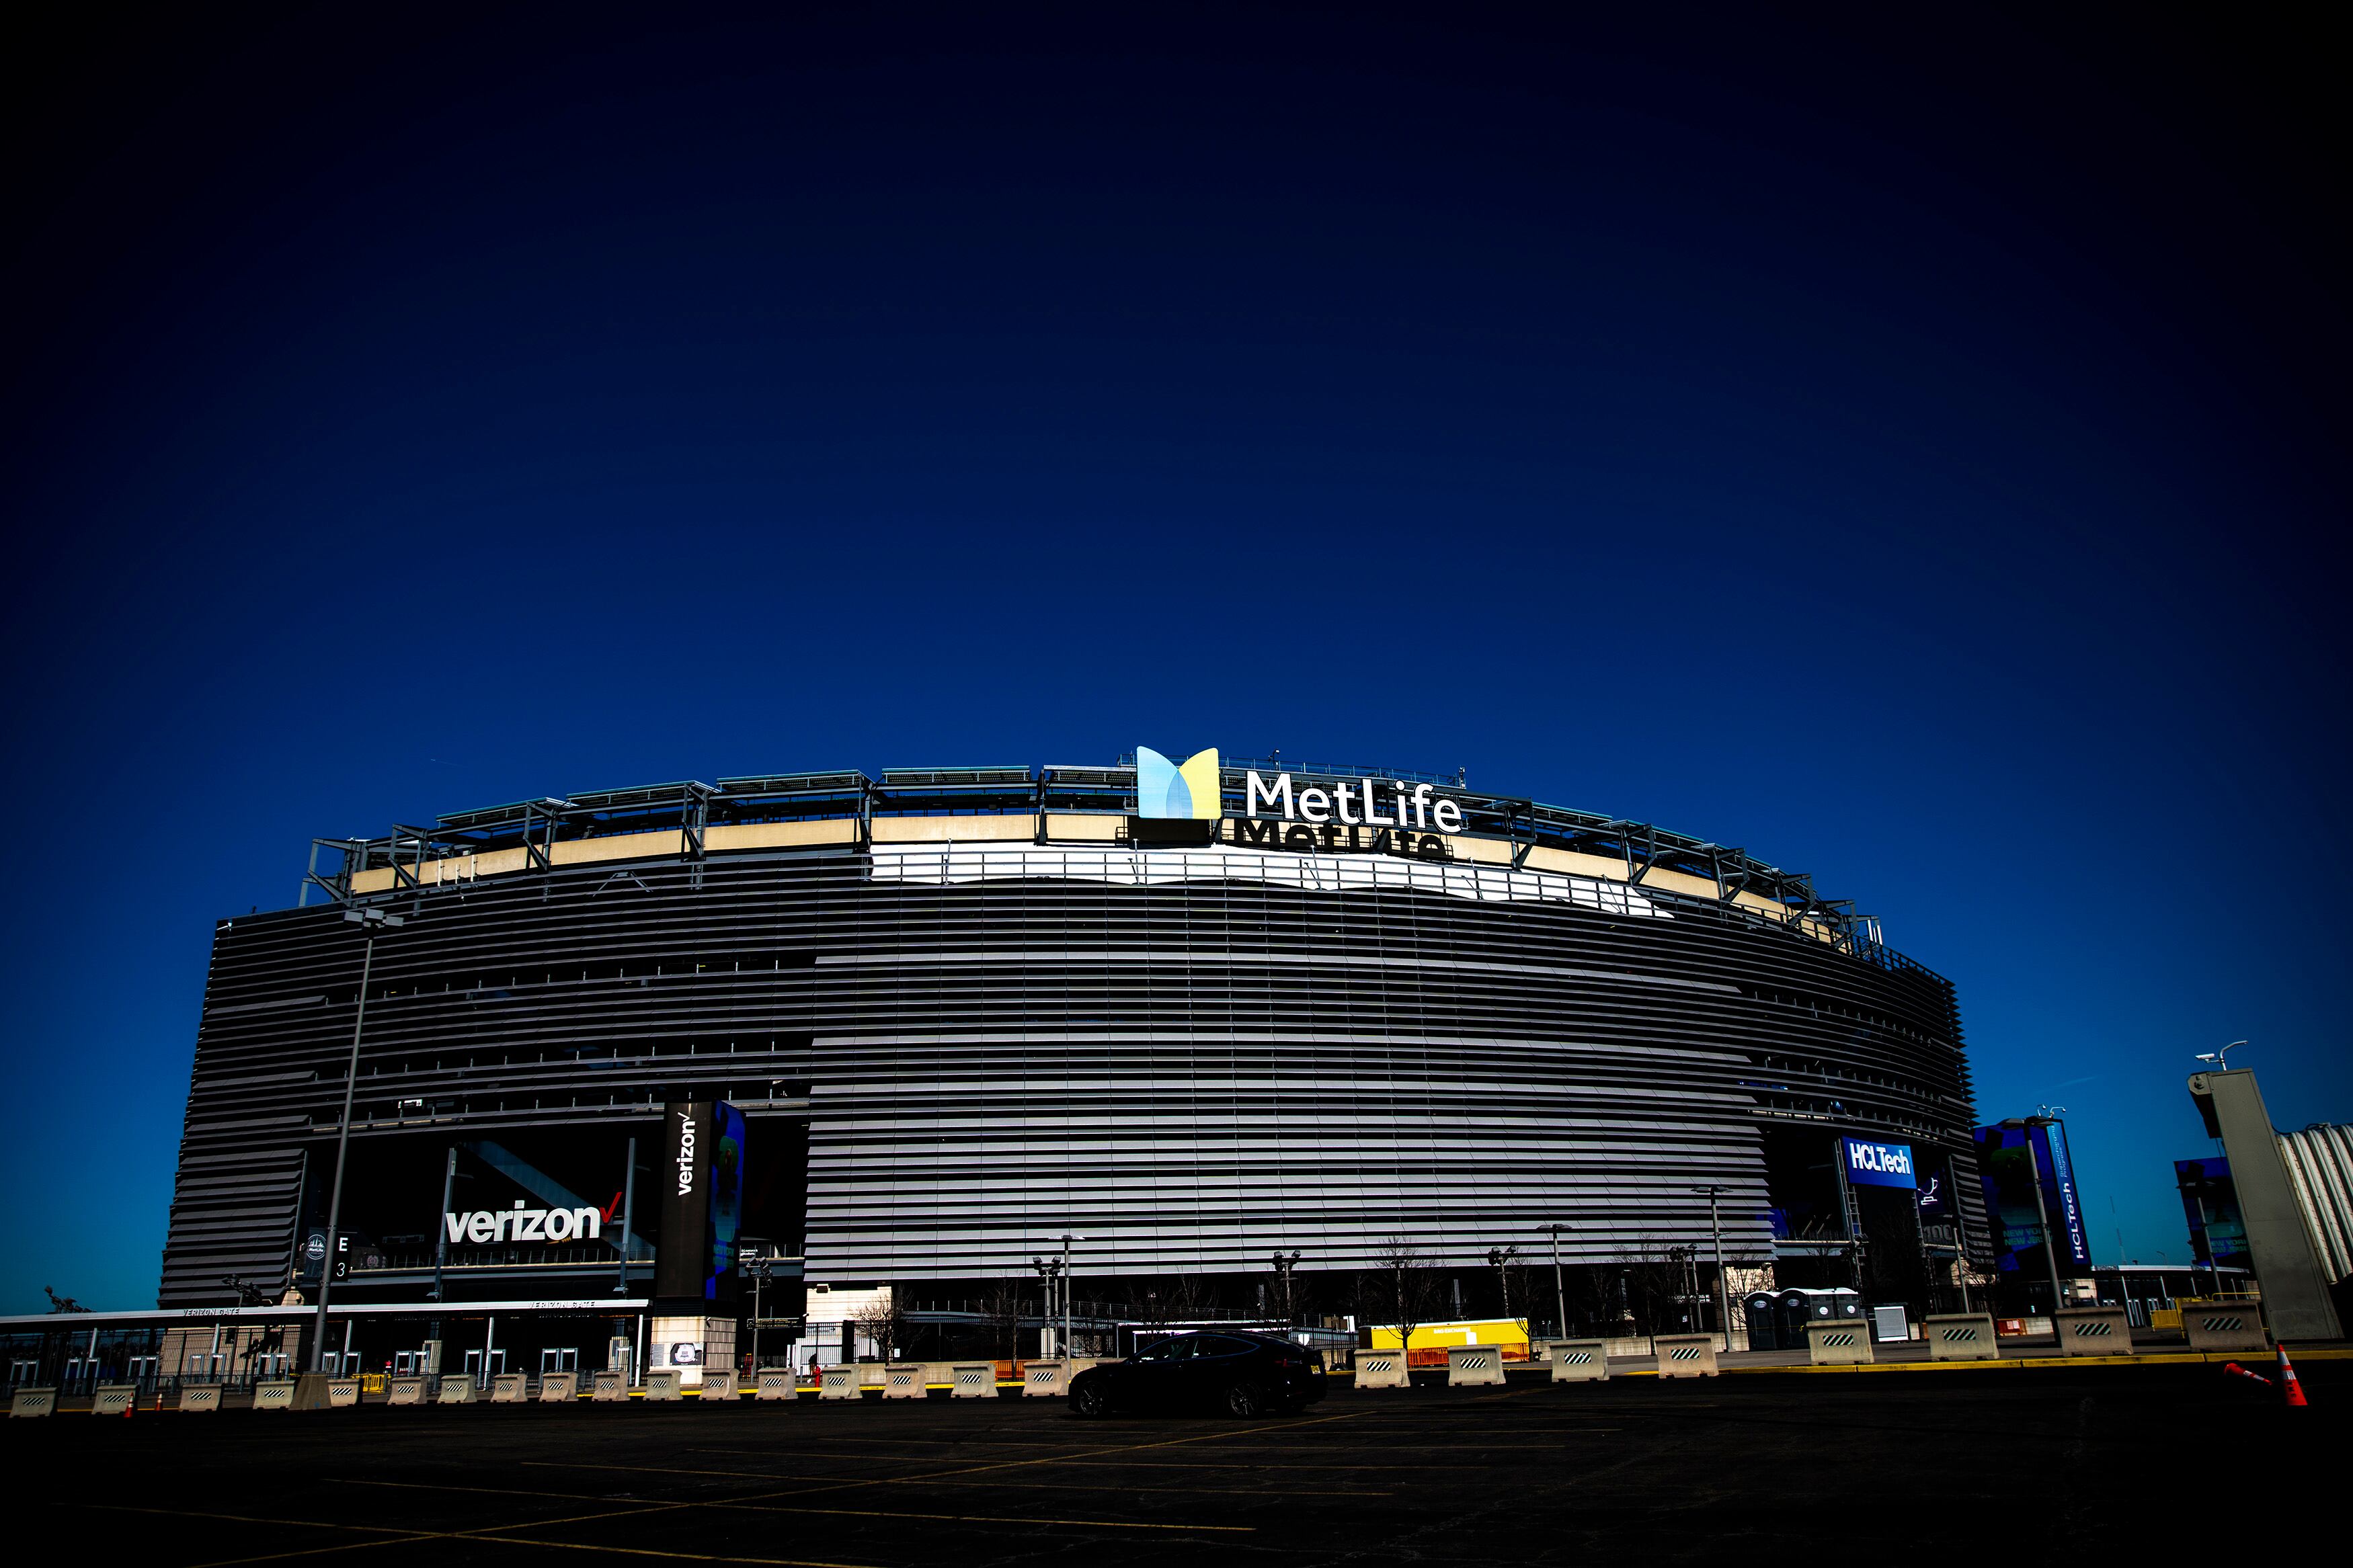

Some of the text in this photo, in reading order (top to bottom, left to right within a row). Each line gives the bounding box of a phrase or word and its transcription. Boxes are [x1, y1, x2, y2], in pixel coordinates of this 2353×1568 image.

[1245, 770, 1463, 834] MetLife
[676, 1120, 696, 1197] verizon
[1849, 1143, 1911, 1175] HCLTech
[445, 1200, 601, 1243] verizon
[2063, 1182, 2085, 1260] HCLTech
[339, 1237, 348, 1251] E
[336, 1262, 346, 1277] 3
[184, 1307, 240, 1317] VERIZON GATE
[528, 1301, 596, 1309] VERIZON GATE
